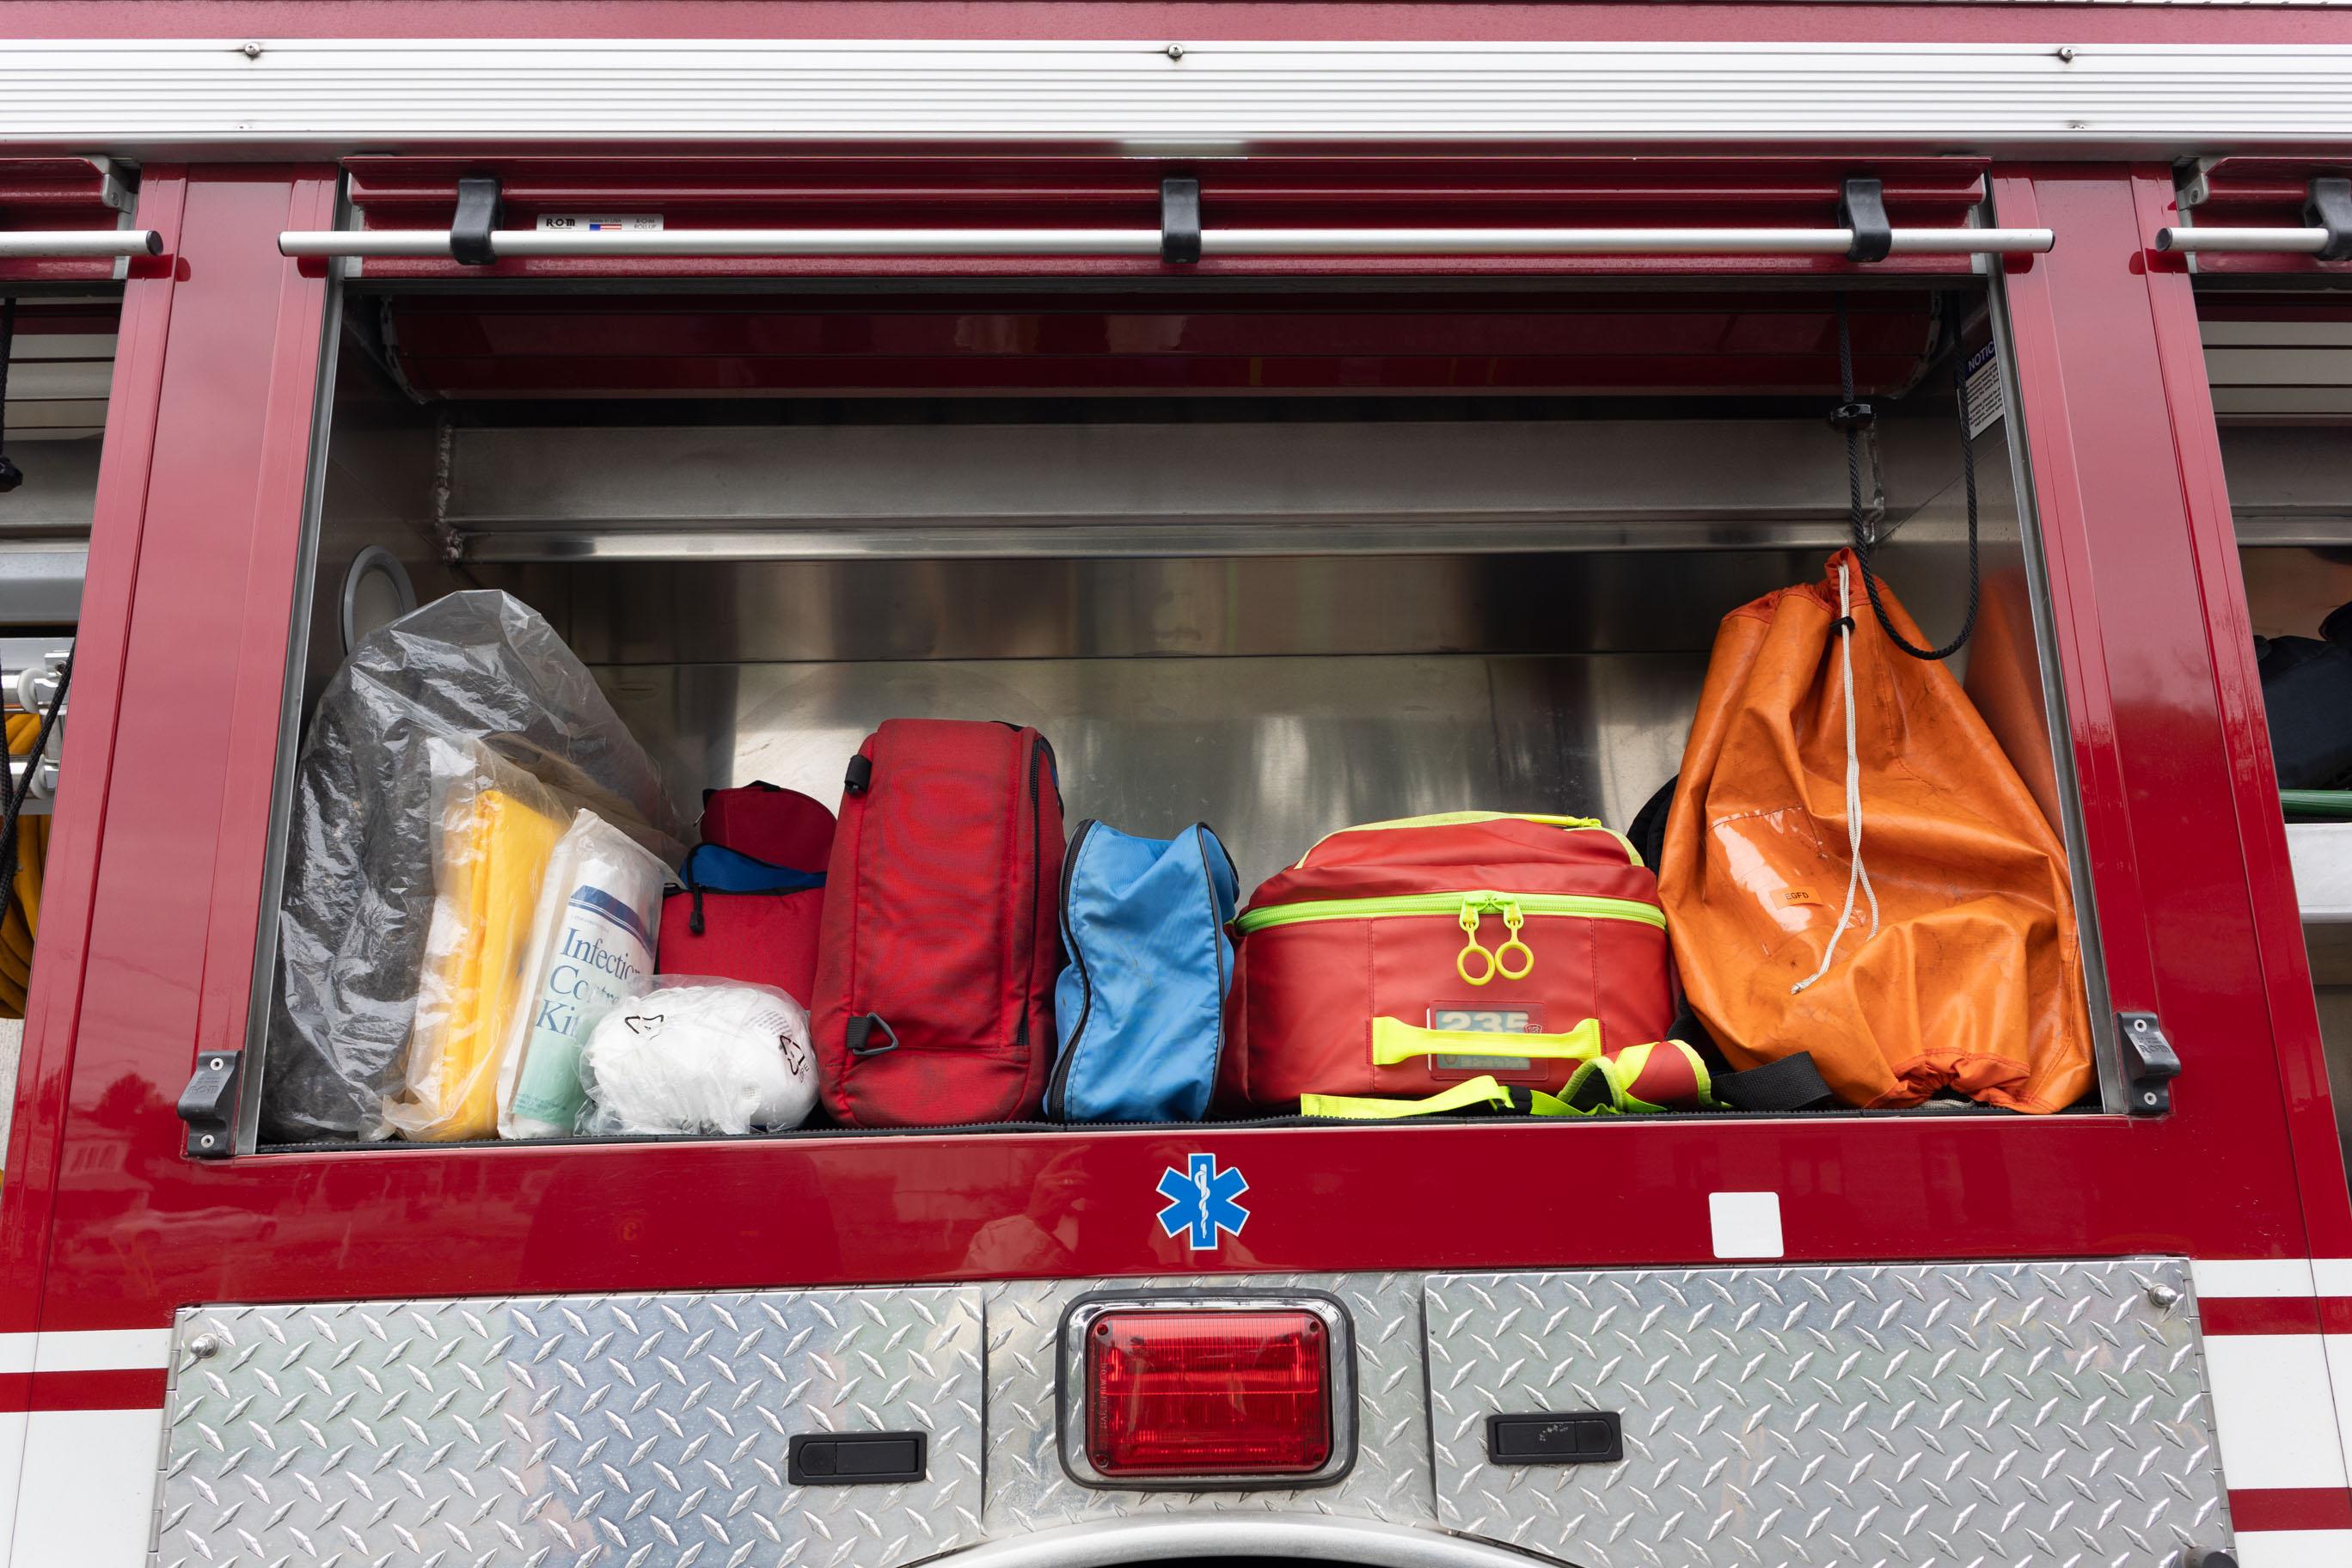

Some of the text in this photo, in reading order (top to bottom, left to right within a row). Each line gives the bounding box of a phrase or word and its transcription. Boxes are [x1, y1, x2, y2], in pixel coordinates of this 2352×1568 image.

[1968, 340, 1994, 371] NOTIC
[1784, 891, 1810, 900] EGFD
[560, 927, 640, 980] Infectio
